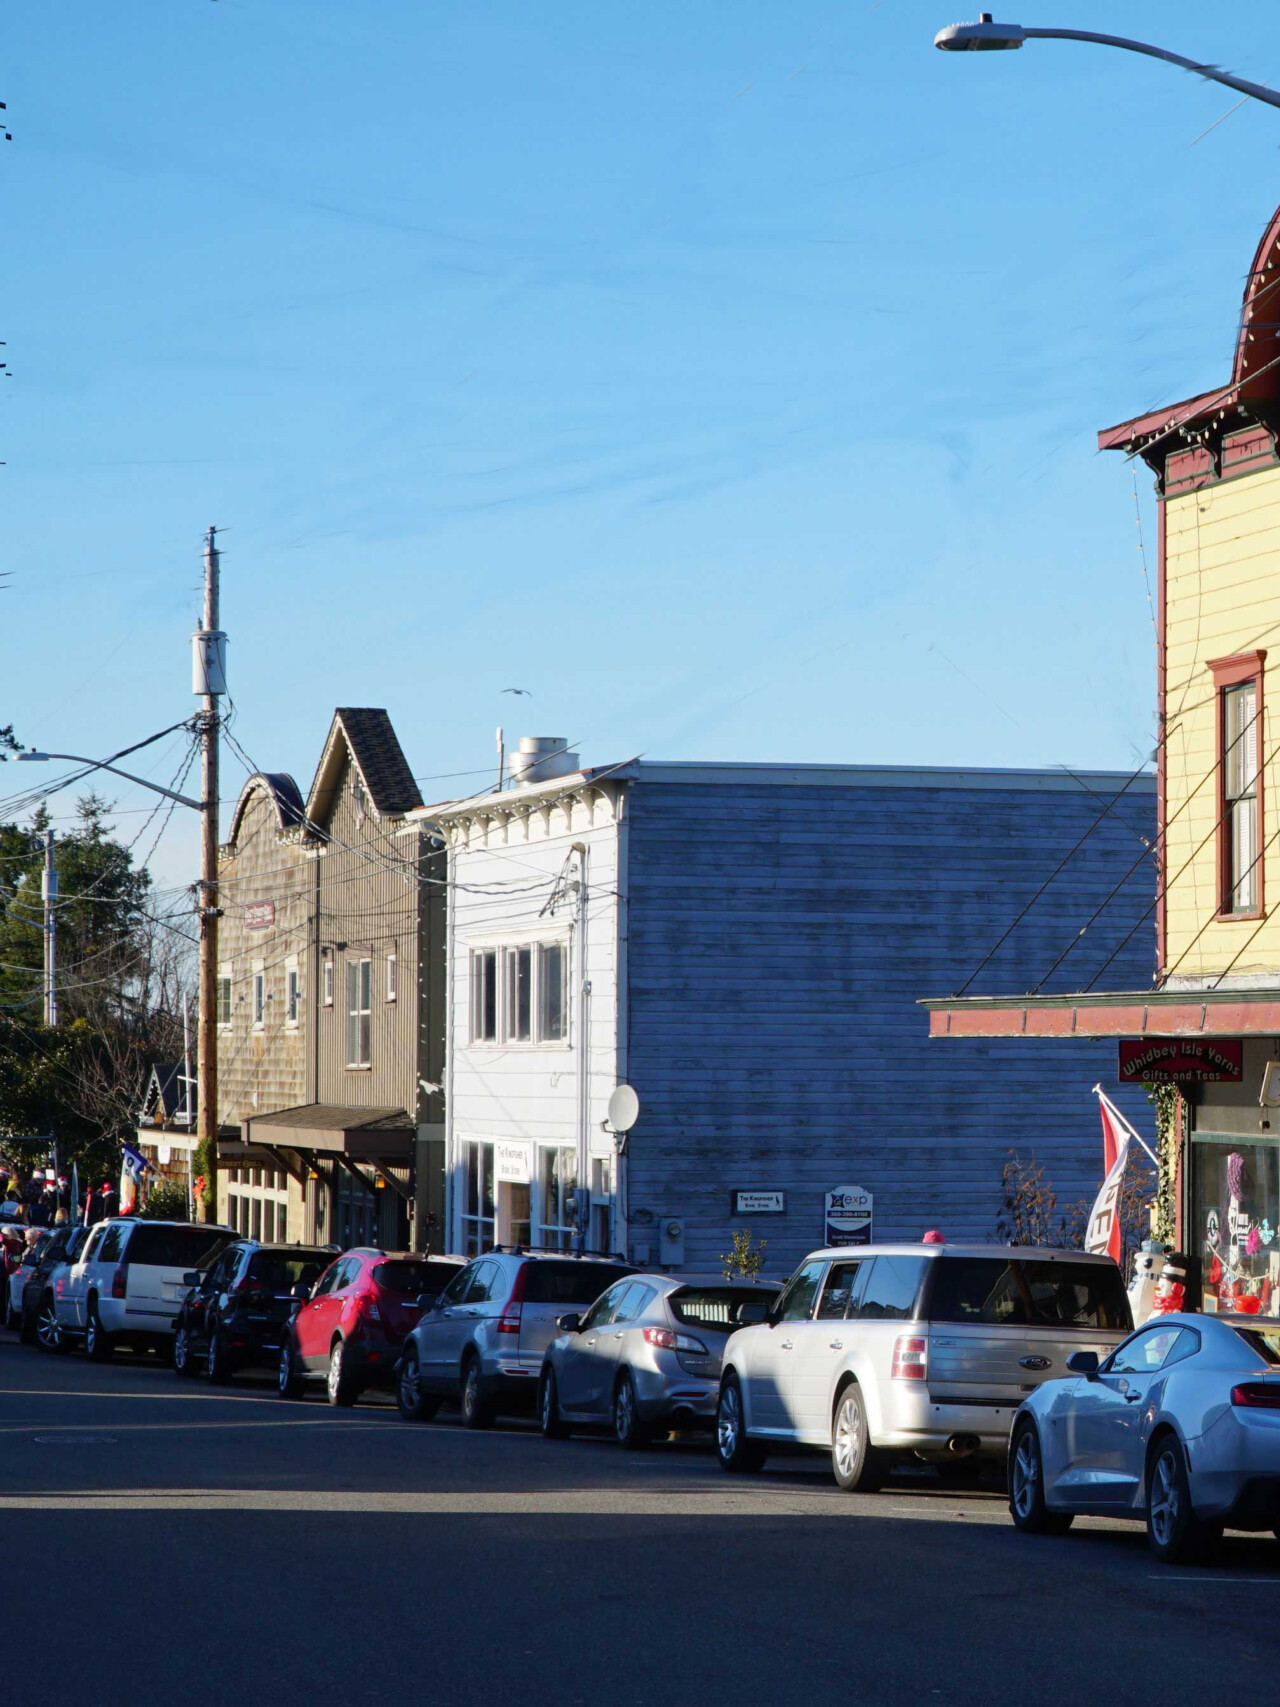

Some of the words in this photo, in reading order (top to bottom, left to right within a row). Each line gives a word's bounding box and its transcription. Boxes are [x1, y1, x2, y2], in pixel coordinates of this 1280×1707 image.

[1123, 1045, 1177, 1076] Whidbey
[1181, 1042, 1203, 1056] Isle
[1208, 1047, 1240, 1076] Yarns
[1142, 1070, 1168, 1080] Gifts
[1173, 1070, 1192, 1080] and
[1196, 1071, 1220, 1080] Teas
[844, 1195, 868, 1205] exp
